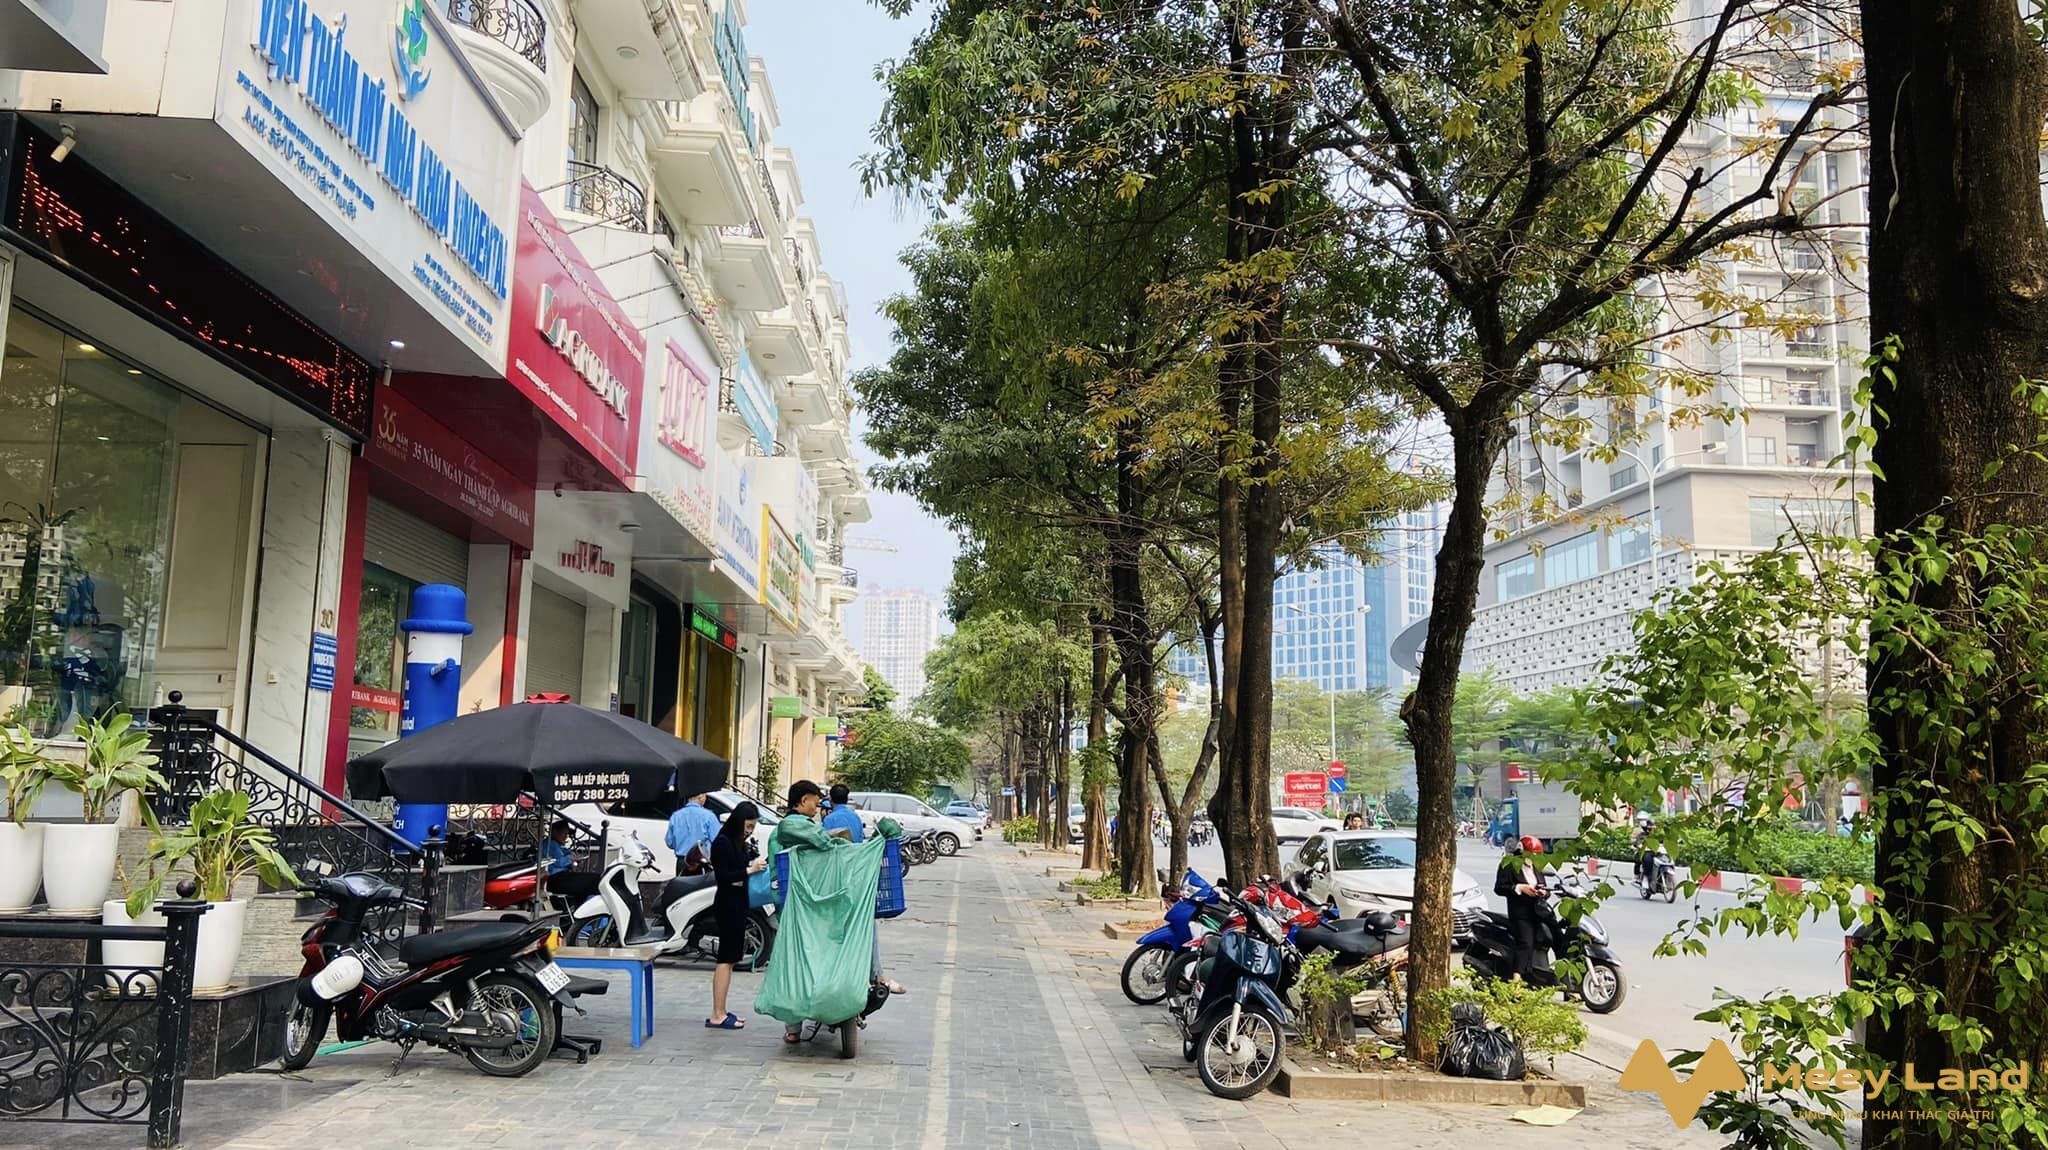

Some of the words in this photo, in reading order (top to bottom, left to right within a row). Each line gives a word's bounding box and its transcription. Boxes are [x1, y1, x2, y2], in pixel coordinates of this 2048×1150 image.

[384, 102, 417, 201] NHA
[415, 139, 452, 242] KHOA
[556, 317, 629, 422] AGRIBANK
[554, 789, 581, 801] 0967
[583, 788, 605, 800] 380
[607, 788, 629, 800] 234
